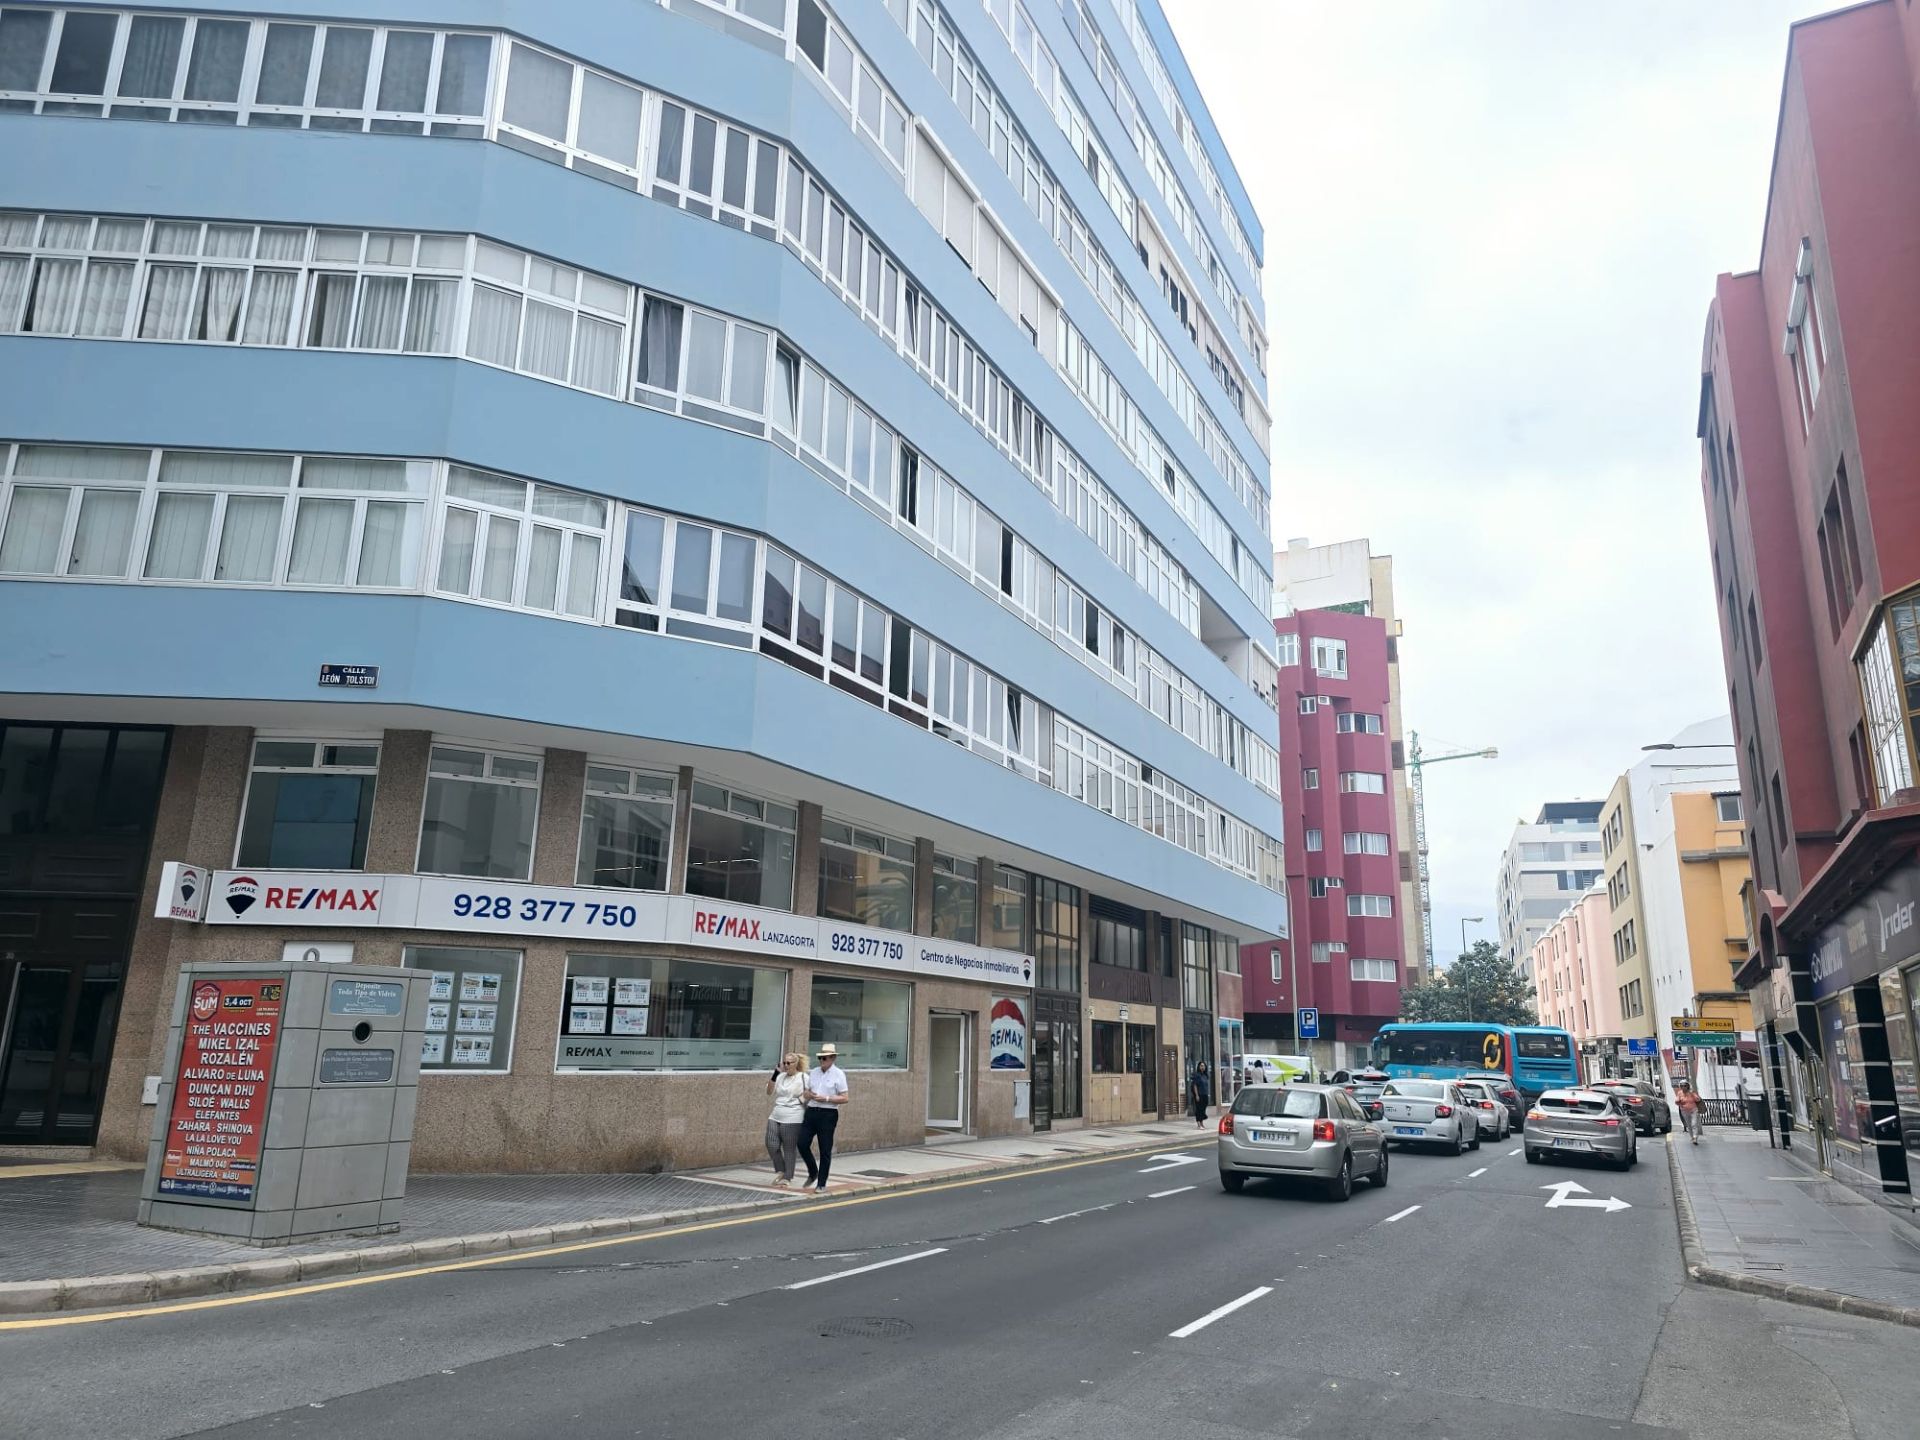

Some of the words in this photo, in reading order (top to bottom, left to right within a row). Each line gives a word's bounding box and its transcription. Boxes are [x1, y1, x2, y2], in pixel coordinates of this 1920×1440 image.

[321, 673, 341, 683] LEÓN
[229, 886, 257, 894] RE/MAX
[265, 887, 380, 911] RE/MAX
[170, 906, 198, 919] RE/MAX
[453, 893, 512, 920] 928
[519, 898, 576, 923] 377
[584, 903, 637, 928] 750
[695, 911, 761, 941] RE/MAX
[762, 930, 815, 949] LANZAGORTA
[831, 933, 855, 953] 928
[857, 937, 880, 957] 377
[882, 941, 904, 961] 750
[921, 949, 944, 964] Centro
[945, 953, 954, 965] de
[954, 955, 983, 969] Negocios
[984, 960, 1020, 975] Inmobiliarios
[354, 989, 368, 997] Tipo
[1304, 1012, 1313, 1025] P
[193, 1025, 211, 1035] THE
[213, 1023, 272, 1036] VACCINES
[198, 1038, 232, 1050] MIKEL
[235, 1038, 260, 1051] IZAL
[991, 1028, 1023, 1050] RE/MAX
[566, 1046, 612, 1057] RE/MAX
[200, 1051, 254, 1066] ROZALÉN
[184, 1067, 225, 1080] ALVARO
[226, 1072, 236, 1080] DE
[237, 1069, 265, 1081] LUNA
[188, 1083, 231, 1095] DUNCAN
[234, 1084, 256, 1096] DHU
[188, 1096, 216, 1108] SILOÉ
[220, 1098, 250, 1110] WALLS
[195, 1110, 240, 1120] ELEFANTES
[177, 1121, 211, 1131] ZAHARA
[216, 1122, 253, 1134] SHINOVA
[185, 1133, 195, 1142] LA
[196, 1134, 205, 1143] LA
[206, 1134, 226, 1144] LOVE
[227, 1136, 242, 1145] YOU
[186, 1144, 205, 1156] NIÑA
[206, 1147, 237, 1158] POLACA
[176, 1168, 218, 1178] ULTRALIGERA
